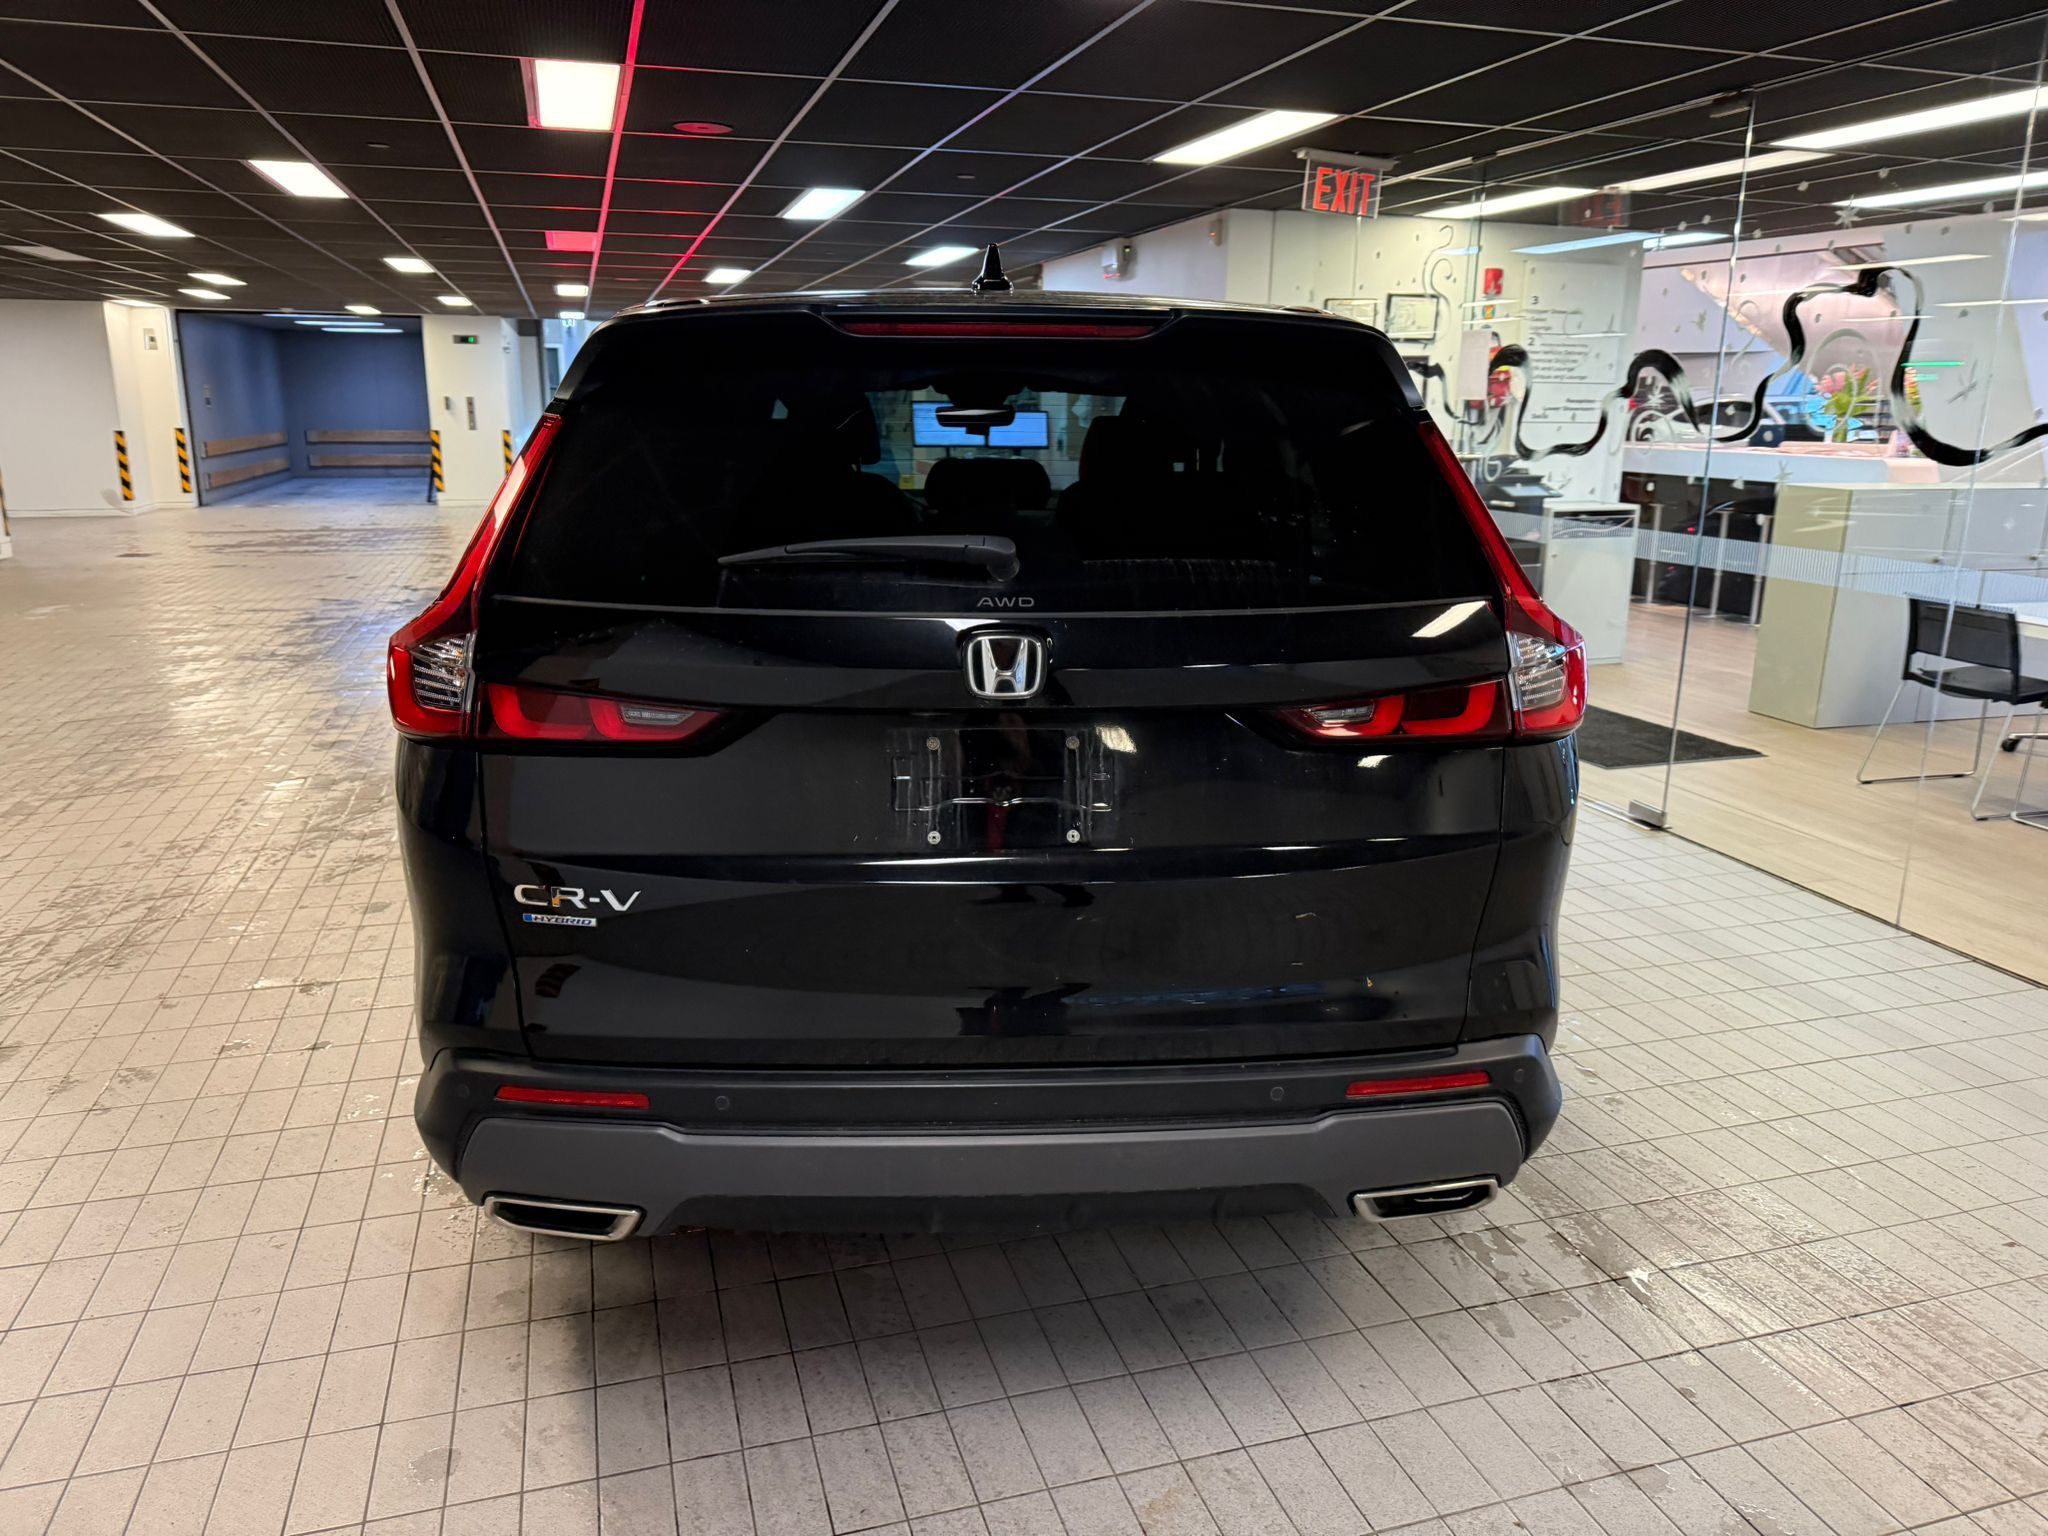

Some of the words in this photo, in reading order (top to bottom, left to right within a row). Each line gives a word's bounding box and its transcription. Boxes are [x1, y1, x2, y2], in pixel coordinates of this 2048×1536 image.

[1313, 166, 1376, 216] EXIT
[1531, 295, 1539, 305] 3
[1527, 336, 1535, 346] 2
[977, 597, 1035, 607] AWD
[514, 884, 641, 912] CR-V
[532, 914, 594, 926] HYBRID
